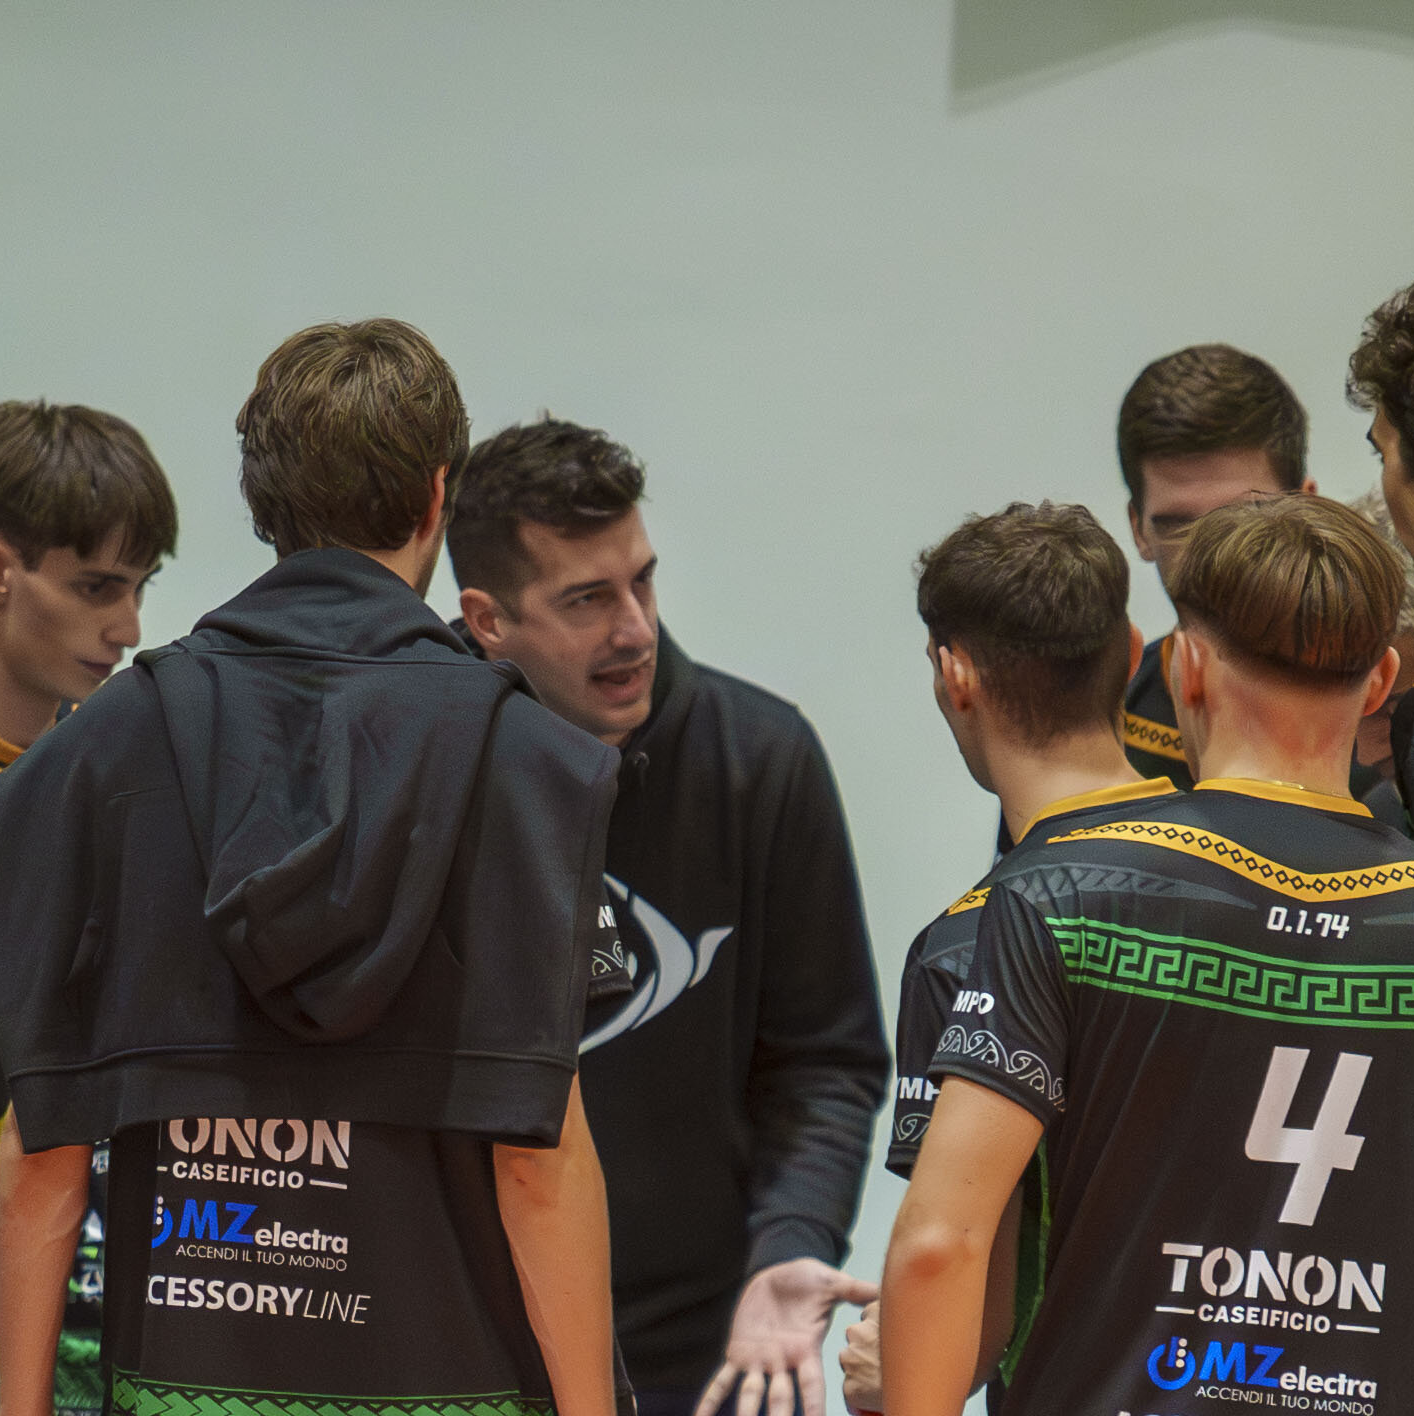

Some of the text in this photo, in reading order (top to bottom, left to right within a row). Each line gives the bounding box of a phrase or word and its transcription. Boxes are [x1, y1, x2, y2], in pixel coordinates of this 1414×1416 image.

[1268, 906, 1350, 939] 0.1.74
[1244, 1046, 1373, 1226] 4
[172, 1161, 304, 1189] CASEIFICIO
[176, 1244, 347, 1272] ACCENDI IL TUO MONDO
[1162, 1242, 1386, 1313] TONON
[1198, 1303, 1331, 1334] CASEIFICIO
[1195, 1385, 1375, 1416] ACCENDI IL TUO MONDO
